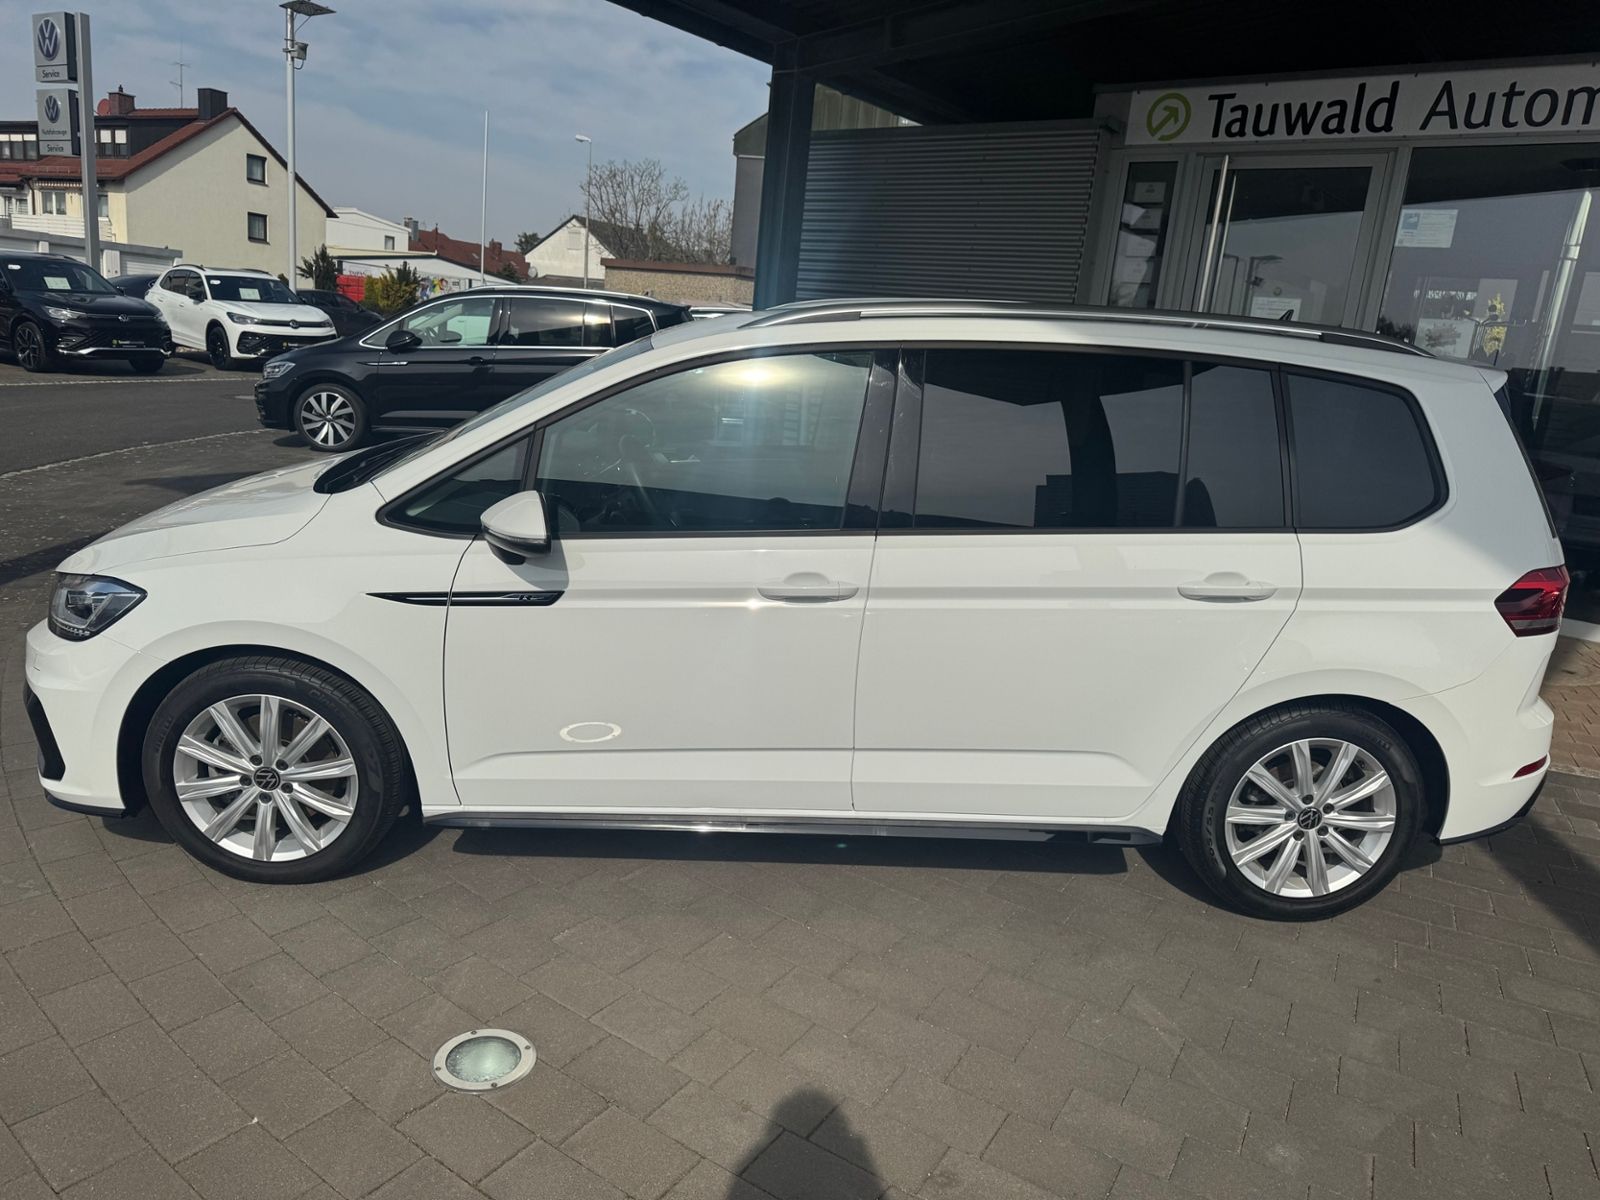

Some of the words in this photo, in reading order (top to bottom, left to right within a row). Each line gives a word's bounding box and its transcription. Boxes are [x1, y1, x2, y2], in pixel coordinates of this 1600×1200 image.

[42, 69, 60, 78] Service
[1208, 80, 1400, 138] Tauwald
[47, 143, 64, 153] Service
